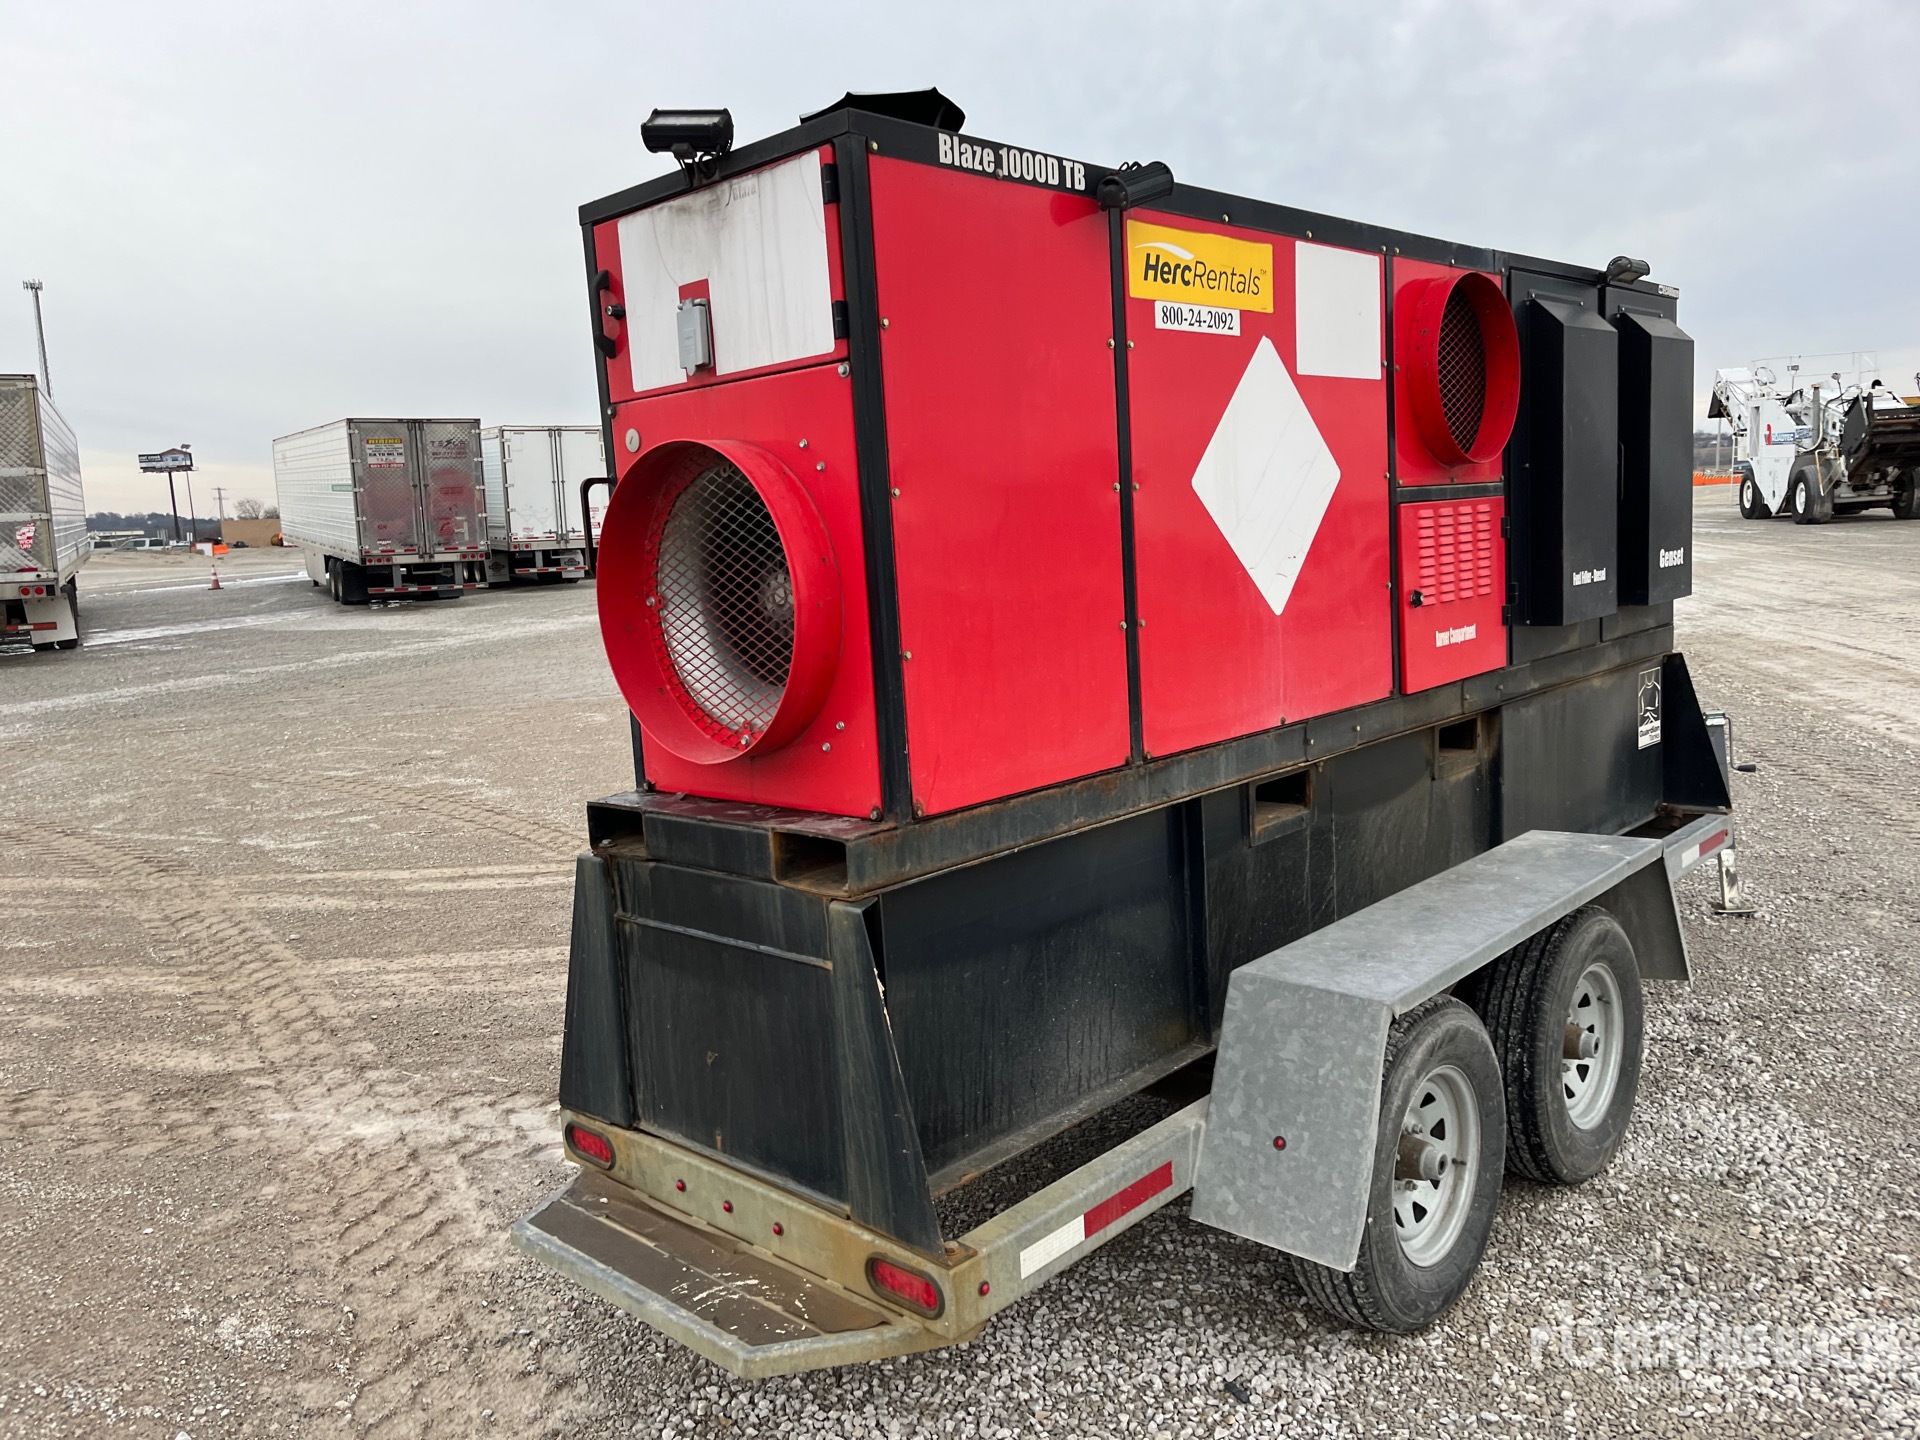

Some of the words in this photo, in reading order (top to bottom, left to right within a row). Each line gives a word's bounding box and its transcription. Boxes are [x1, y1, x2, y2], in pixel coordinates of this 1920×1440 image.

[938, 132, 995, 173] Blaze
[999, 146, 1059, 185] 1000D
[1062, 159, 1086, 191] TB
[1143, 252, 1261, 296] HercRentals
[1161, 305, 1234, 331] 800-24-2092
[1659, 547, 1684, 568] Genset
[1435, 630, 1450, 648] Burner
